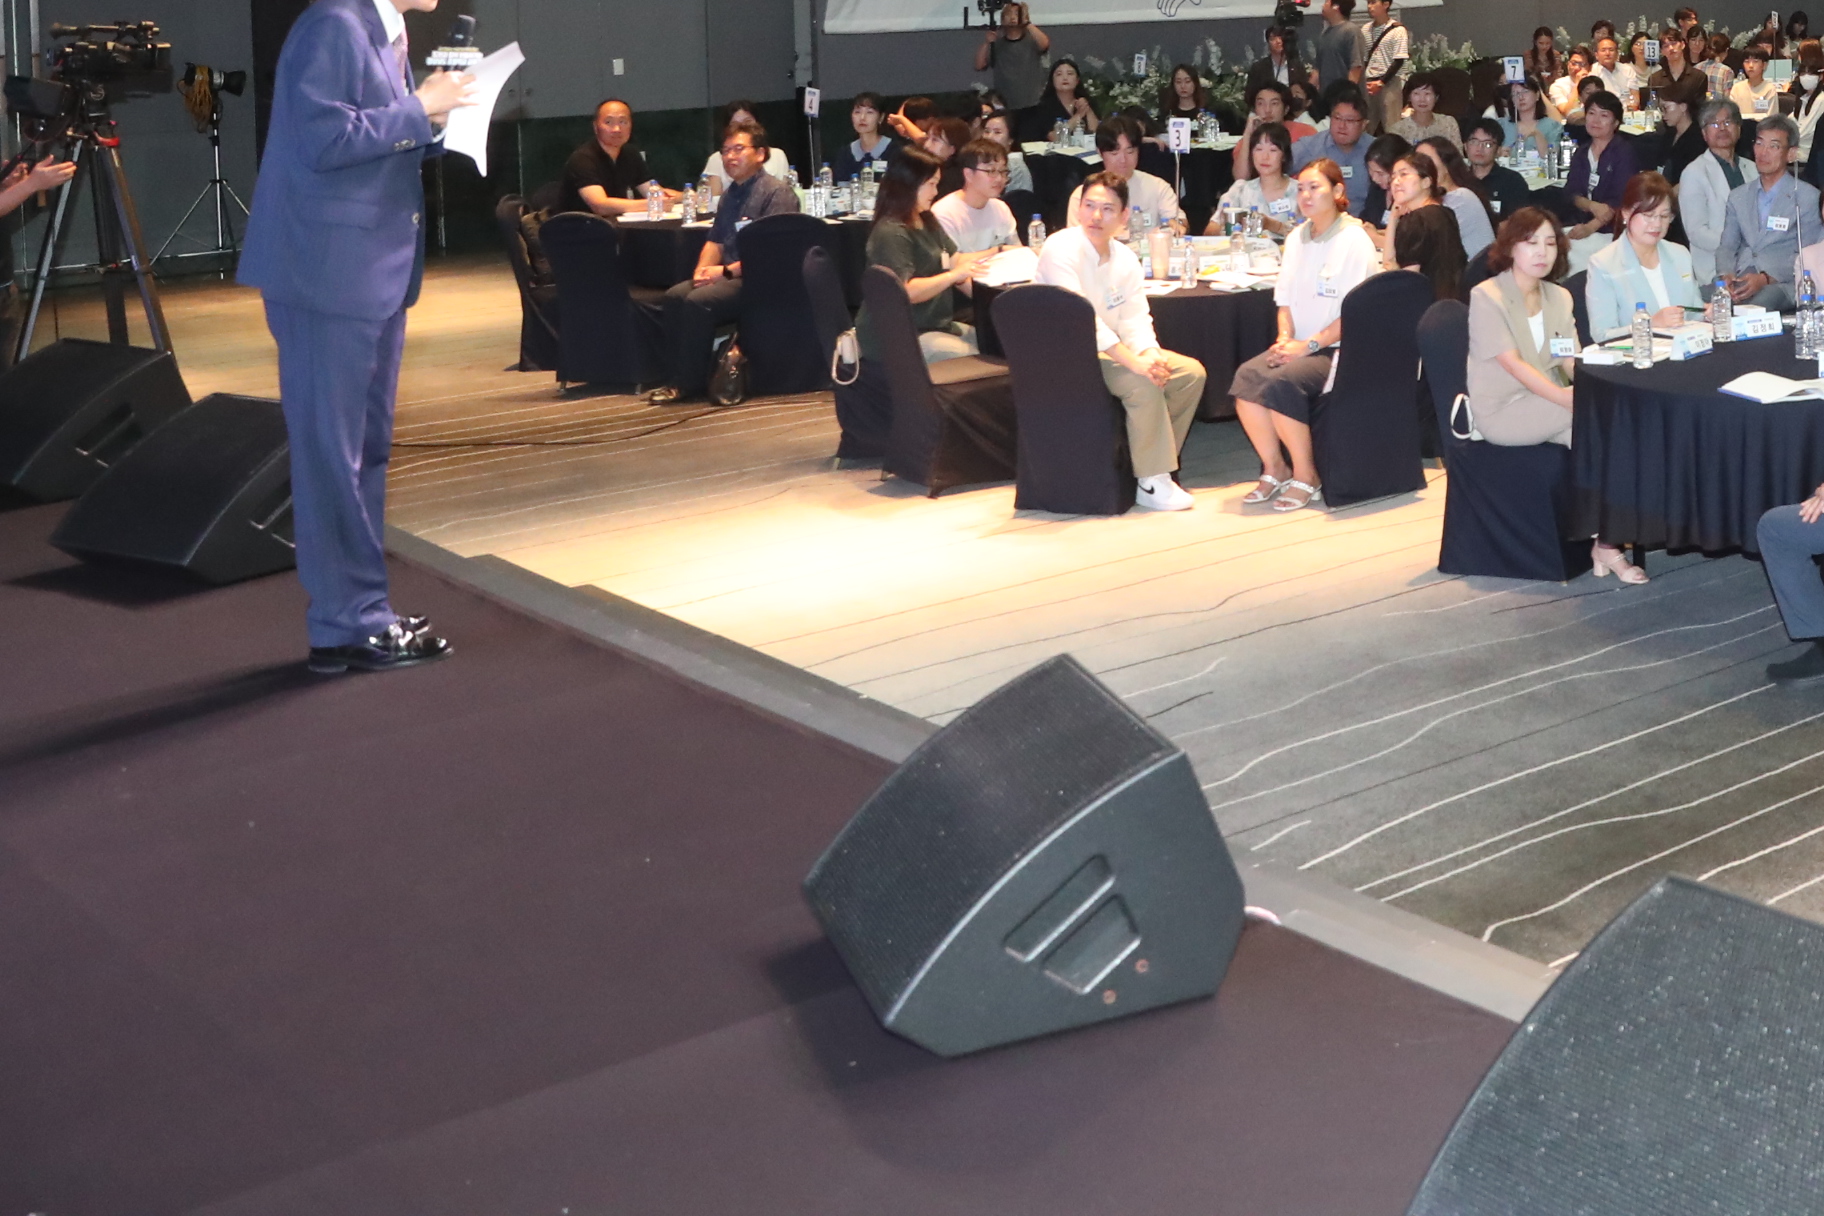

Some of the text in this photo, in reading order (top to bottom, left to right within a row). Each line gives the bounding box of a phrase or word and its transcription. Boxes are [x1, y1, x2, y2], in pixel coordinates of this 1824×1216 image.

[1647, 46, 1656, 58] 13
[1511, 65, 1517, 79] 7
[1175, 130, 1181, 147] 3
